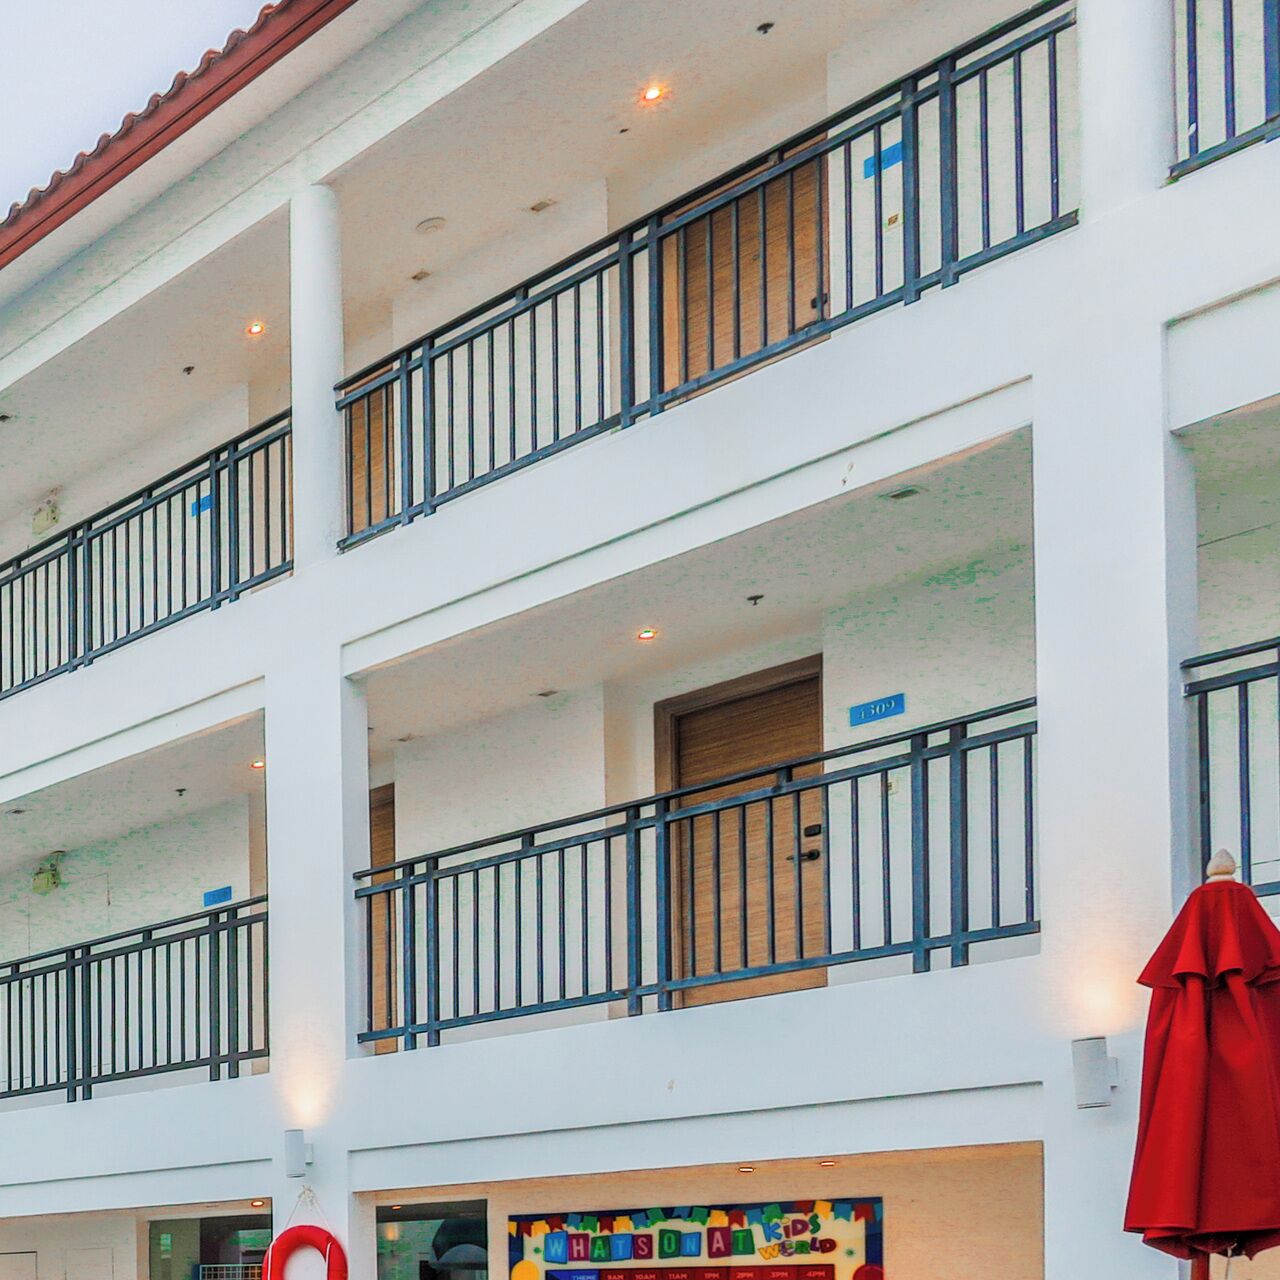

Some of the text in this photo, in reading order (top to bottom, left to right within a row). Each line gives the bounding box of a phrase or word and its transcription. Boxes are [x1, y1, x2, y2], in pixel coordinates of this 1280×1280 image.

[661, 1231, 699, 1256] ON
[710, 1229, 751, 1256] AT
[668, 1272, 688, 1280] 11AM
